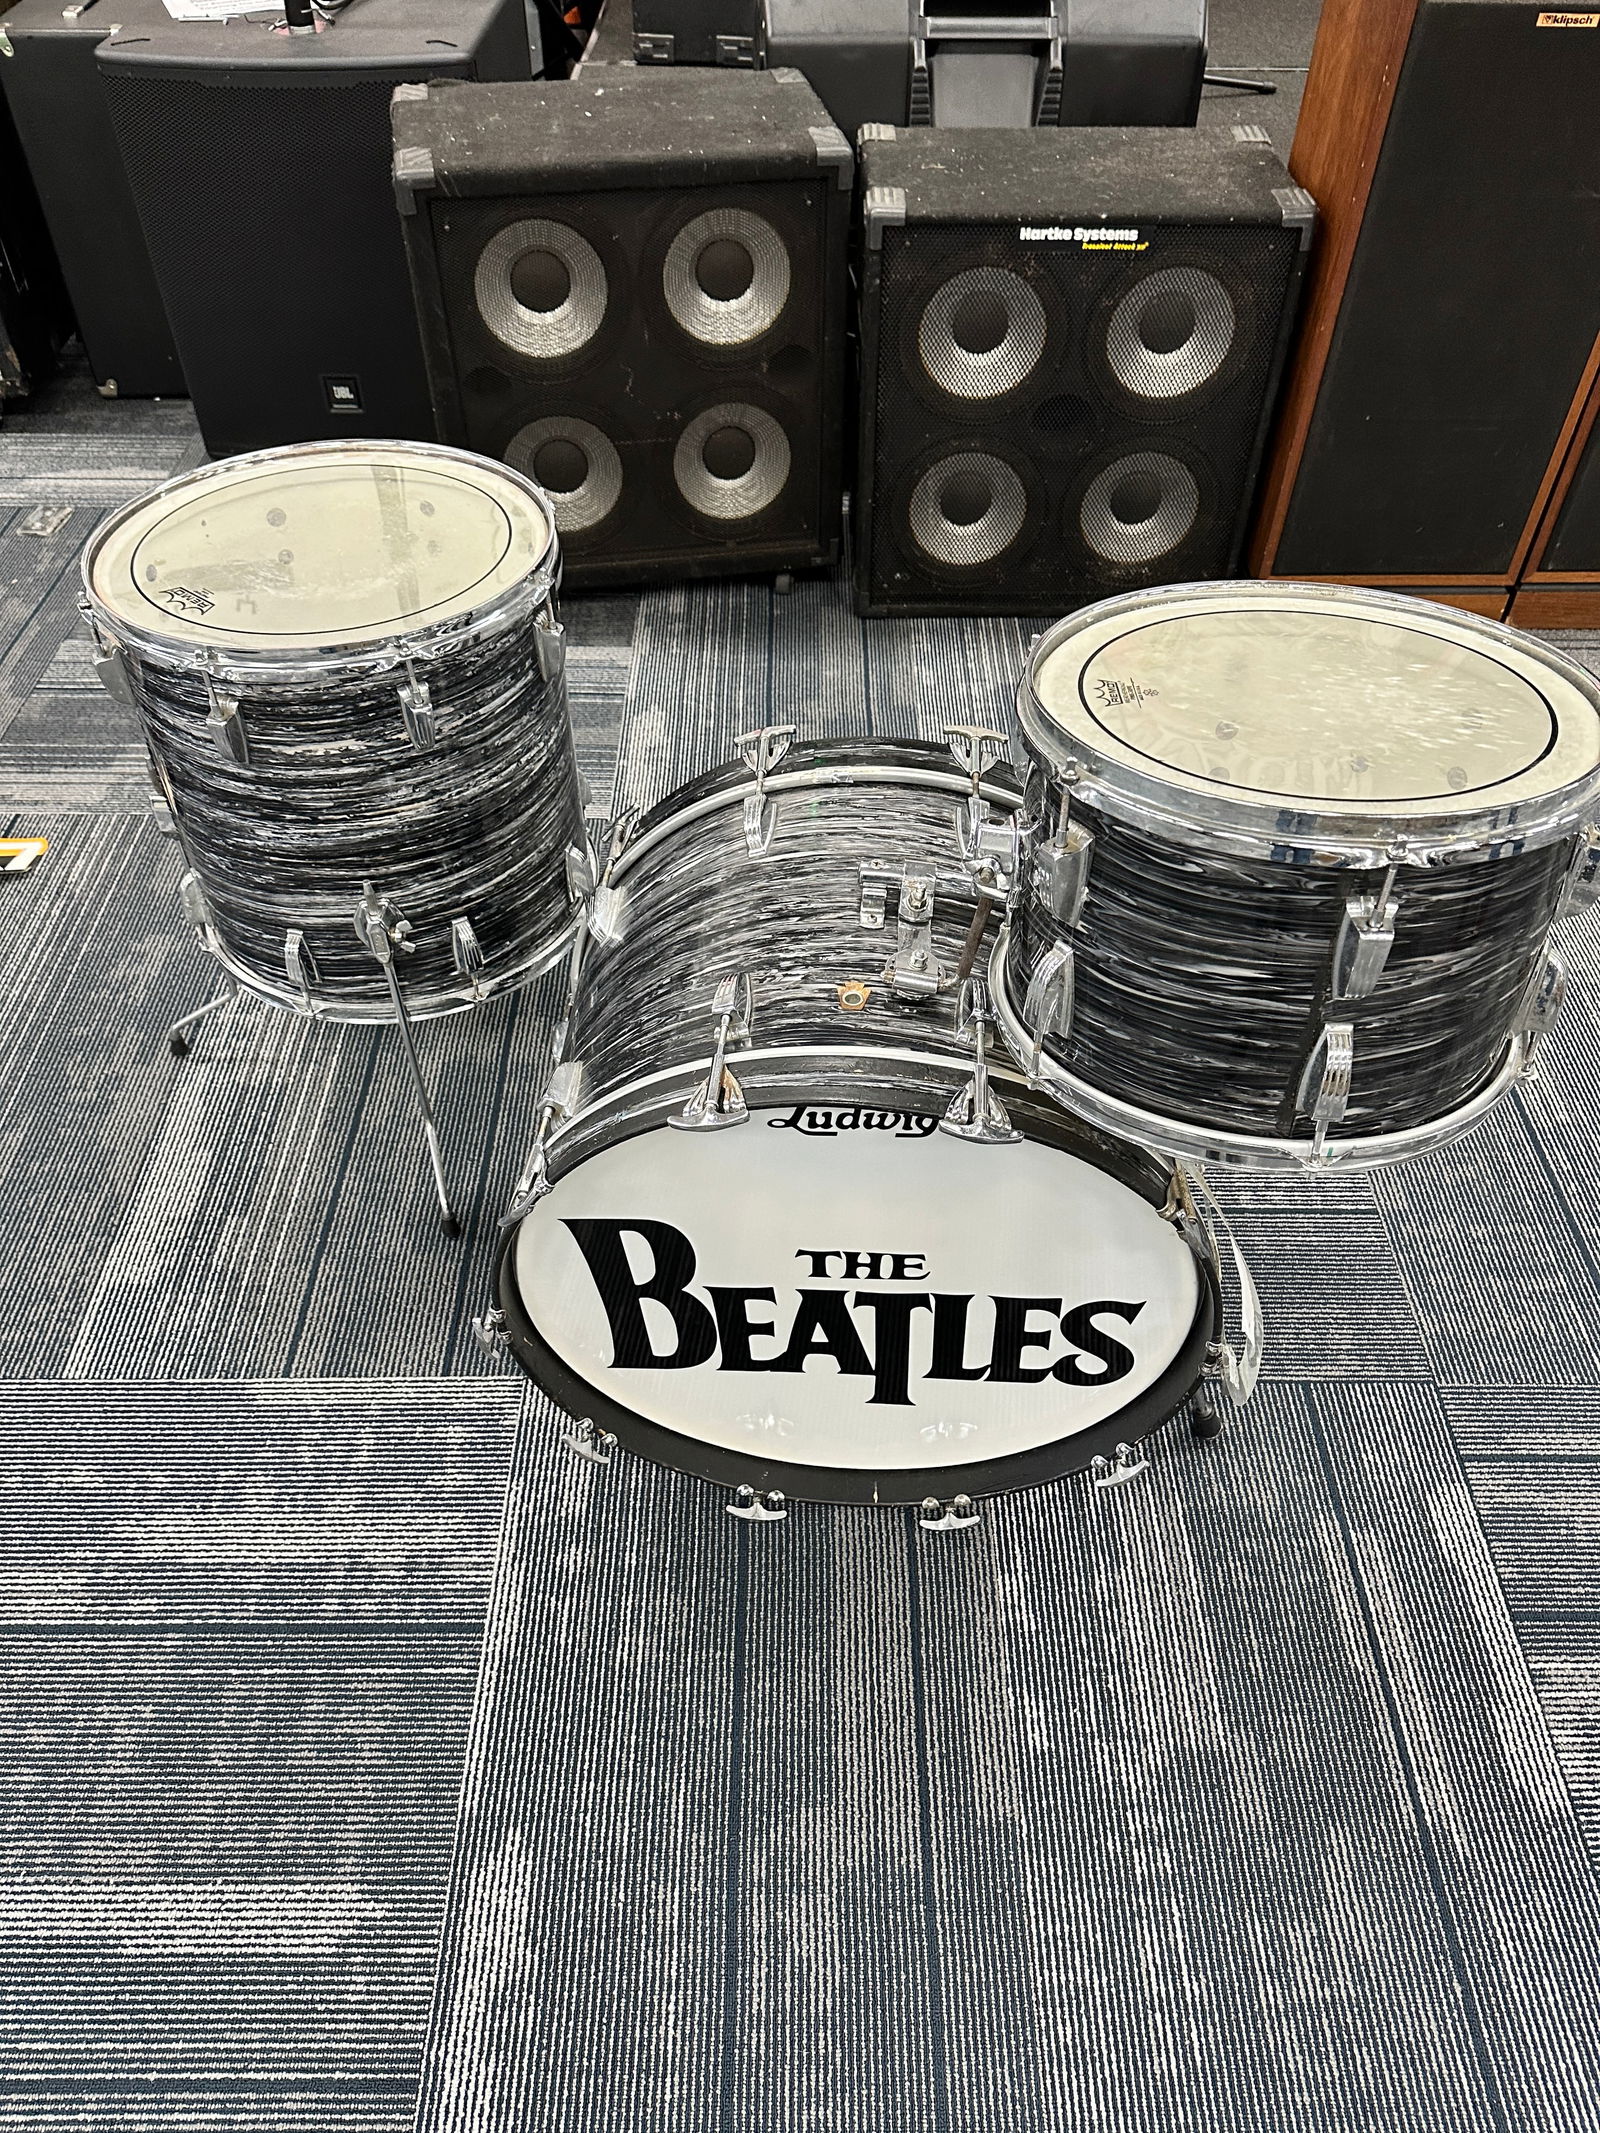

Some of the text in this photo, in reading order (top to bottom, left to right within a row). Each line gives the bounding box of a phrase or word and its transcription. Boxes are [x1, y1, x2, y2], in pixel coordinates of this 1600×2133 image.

[1552, 15, 1593, 27] klipsch
[1019, 227, 1139, 242] Hartke Systems
[767, 1105, 940, 1138] Ludwig
[795, 1249, 931, 1281] THE
[558, 1218, 1148, 1406] BEATLES
